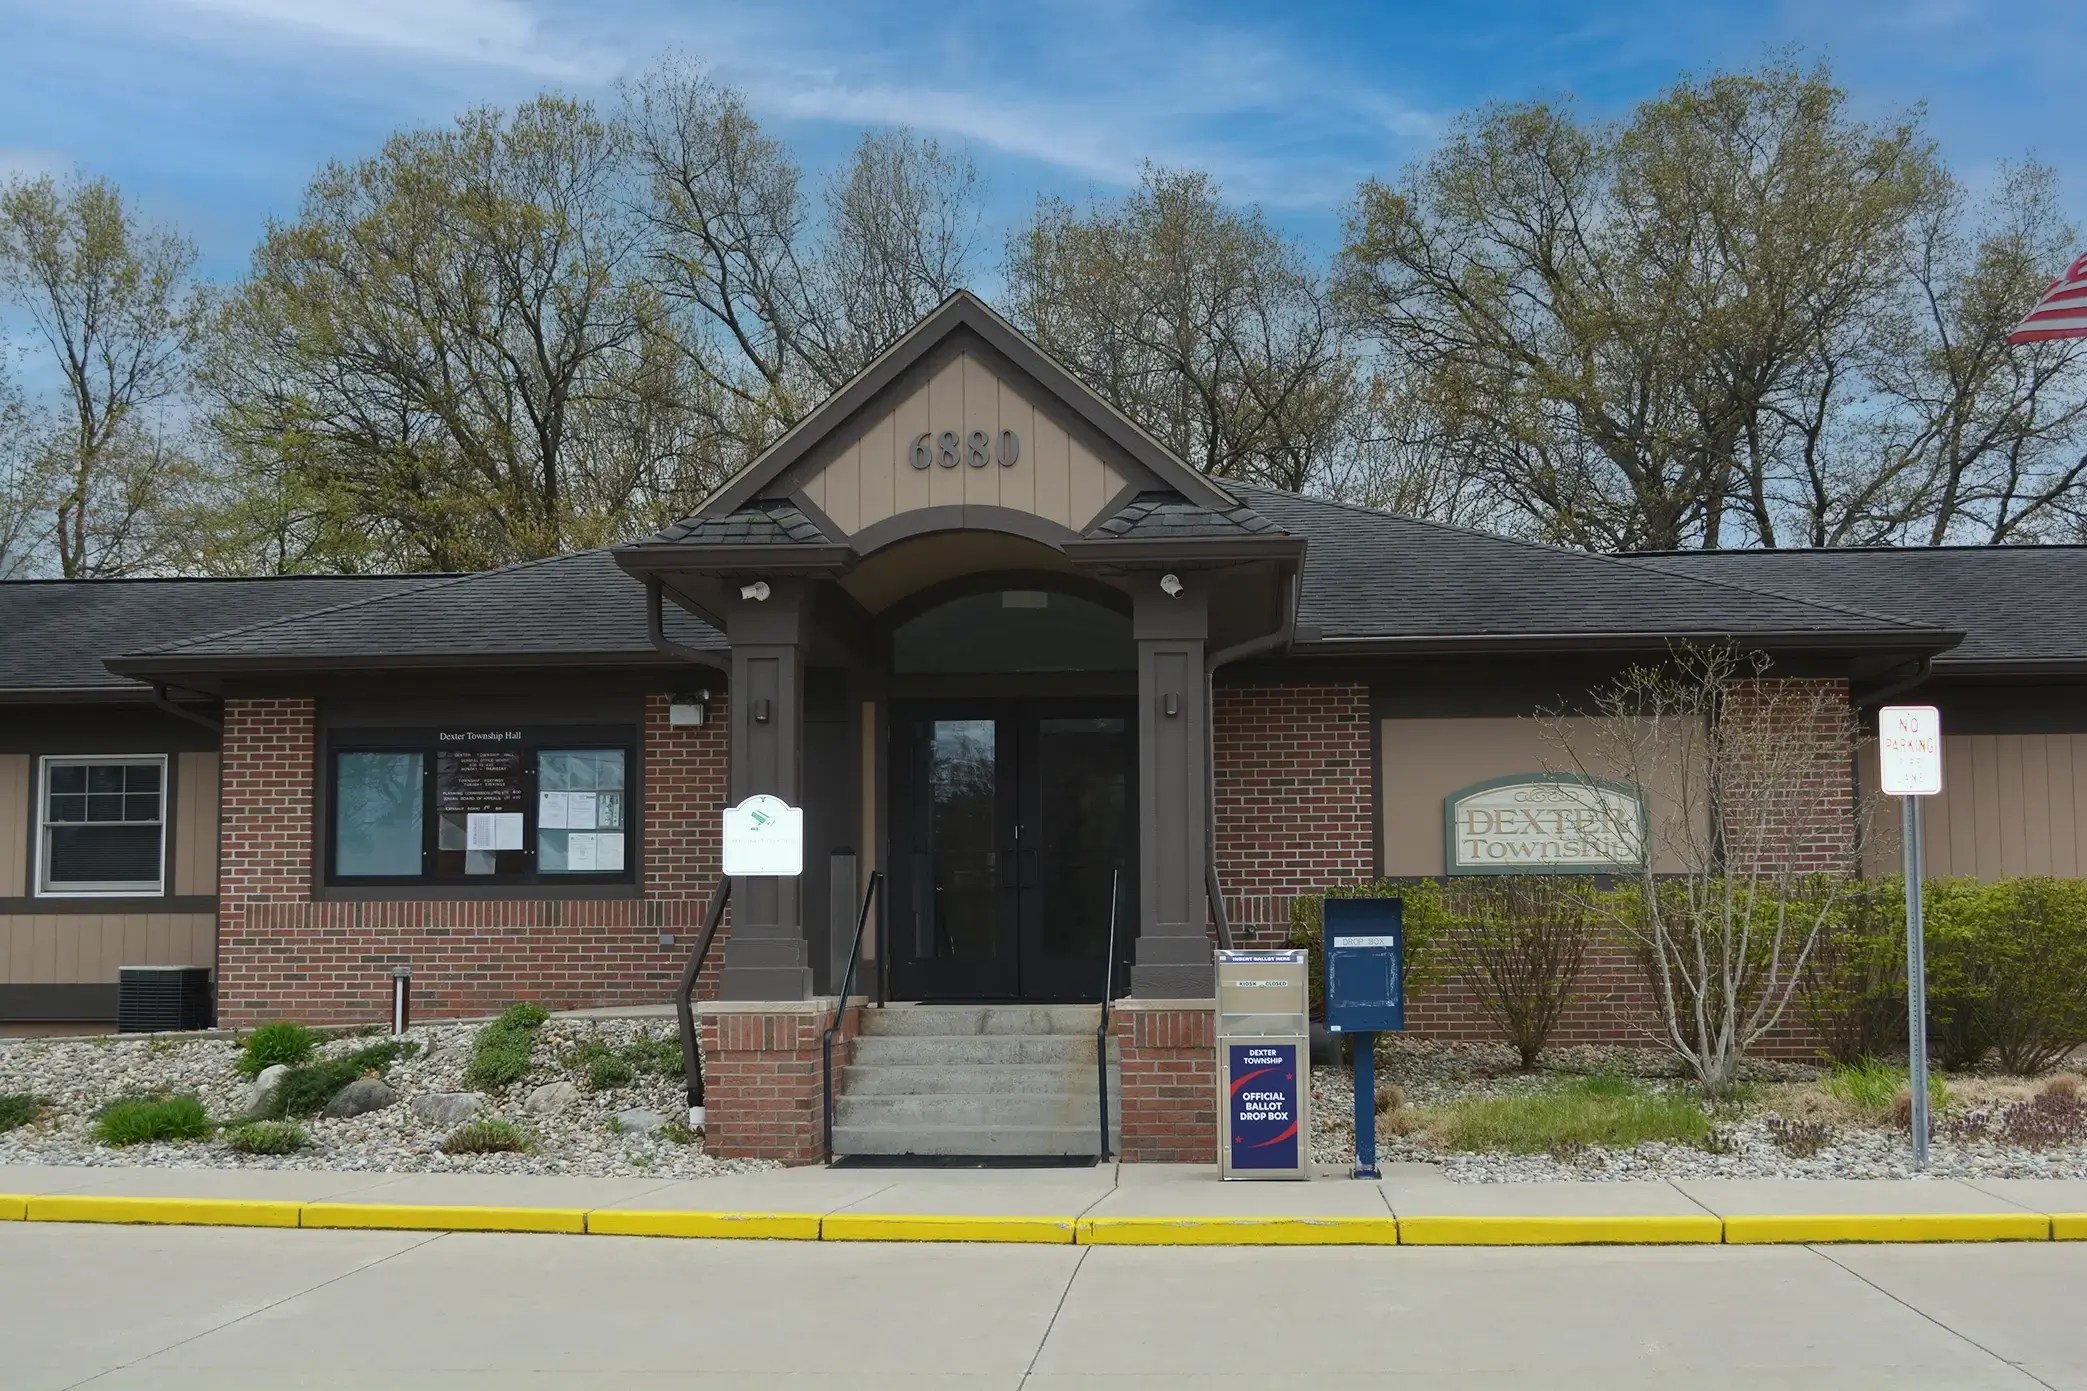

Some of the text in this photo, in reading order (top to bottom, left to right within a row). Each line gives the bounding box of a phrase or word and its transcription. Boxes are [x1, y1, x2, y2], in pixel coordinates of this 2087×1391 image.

[909, 428, 1020, 471] 6880
[1898, 718, 1919, 733] NO
[440, 731, 521, 741] Dexter Township Hall
[1466, 808, 1629, 835] DEXTER
[1463, 837, 1634, 862] Township
[1342, 936, 1386, 946] DROP BOX
[1249, 1049, 1277, 1057] DEXTER
[1243, 1057, 1283, 1065] TOWNSHIP
[1242, 1092, 1286, 1102] OFFICIAL
[1245, 1102, 1283, 1112] BALLOT
[1239, 1112, 1289, 1122] DROP BOX
